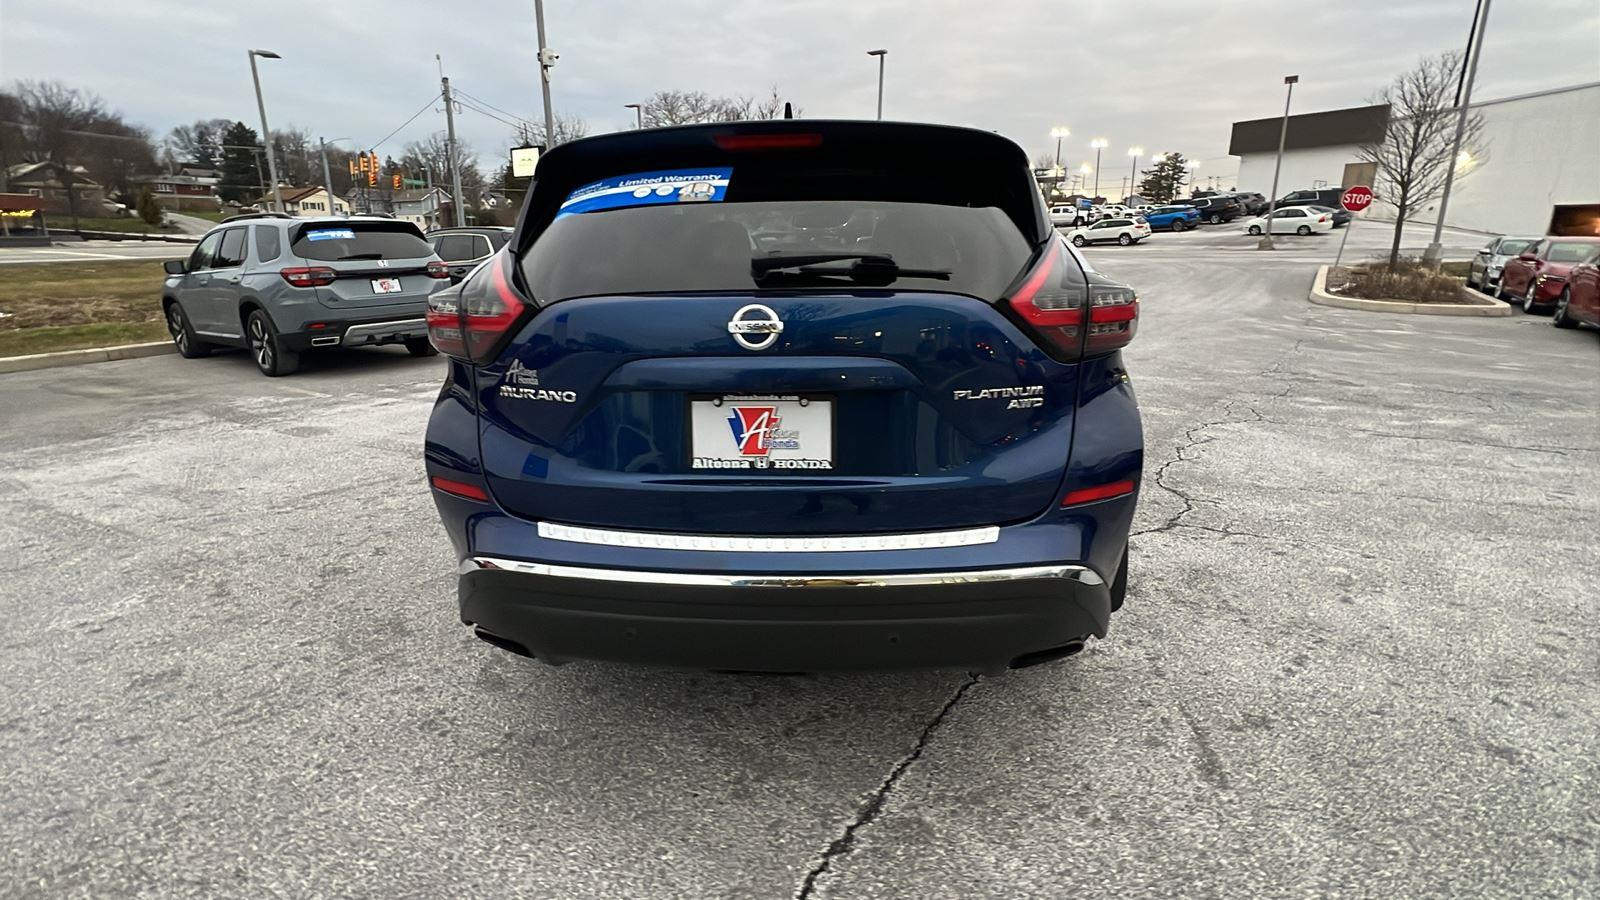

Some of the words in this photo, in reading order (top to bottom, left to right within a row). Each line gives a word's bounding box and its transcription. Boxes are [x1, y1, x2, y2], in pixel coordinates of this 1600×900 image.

[619, 176, 663, 187] Limited
[665, 174, 722, 183] Warranty
[1344, 193, 1371, 204] STOP
[500, 385, 577, 402] MURANO
[953, 385, 1044, 400] PLATINUM
[1006, 397, 1044, 409] AWD
[763, 438, 799, 449] Honda
[693, 458, 750, 469] Altoona
[774, 458, 832, 470] HONDA
